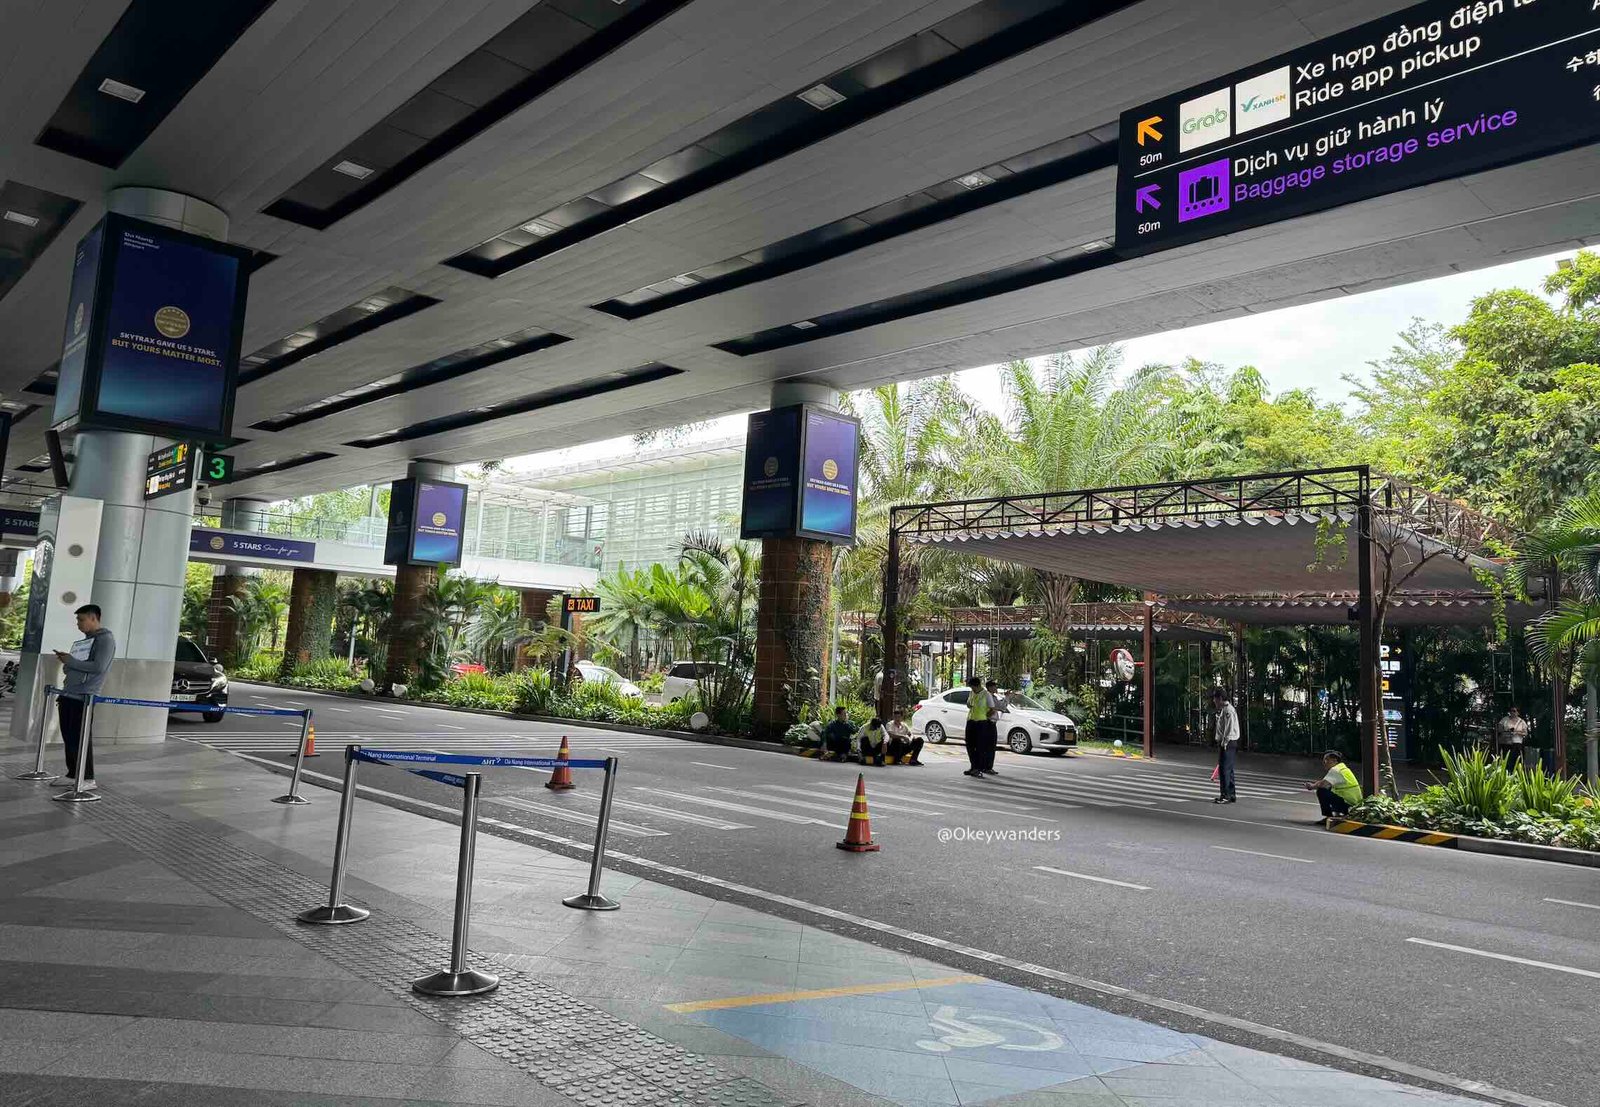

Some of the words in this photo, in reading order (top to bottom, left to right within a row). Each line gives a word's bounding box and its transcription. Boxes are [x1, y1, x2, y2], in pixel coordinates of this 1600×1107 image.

[1295, 62, 1325, 84] Xe
[1332, 44, 1376, 71] hợp
[1382, 20, 1442, 53] đồng
[1449, 0, 1504, 29] điện
[1295, 82, 1344, 111] Ride
[1350, 65, 1393, 91] app
[1401, 36, 1481, 79] pickup
[1182, 107, 1228, 135] Grab
[1234, 150, 1277, 177] Dịch
[1284, 142, 1308, 161] vụ
[1315, 127, 1351, 156] giữ
[1358, 108, 1416, 140] hành
[1424, 97, 1444, 123] lý
[1139, 151, 1163, 166] 50m
[1234, 164, 1326, 202] Baggage
[1332, 137, 1419, 175] storage
[1426, 110, 1518, 148] service
[1138, 220, 1162, 235] 50m
[111, 338, 130, 349] BUT
[131, 342, 161, 354] YOURS
[162, 349, 195, 362] MATTER
[119, 332, 155, 344] SKYTRAX
[156, 339, 176, 349] GAVE
[209, 457, 226, 479] 3
[239, 542, 262, 550] STARS
[576, 599, 594, 611] TAXI
[382, 752, 415, 761] International
[415, 754, 437, 762] Terminal
